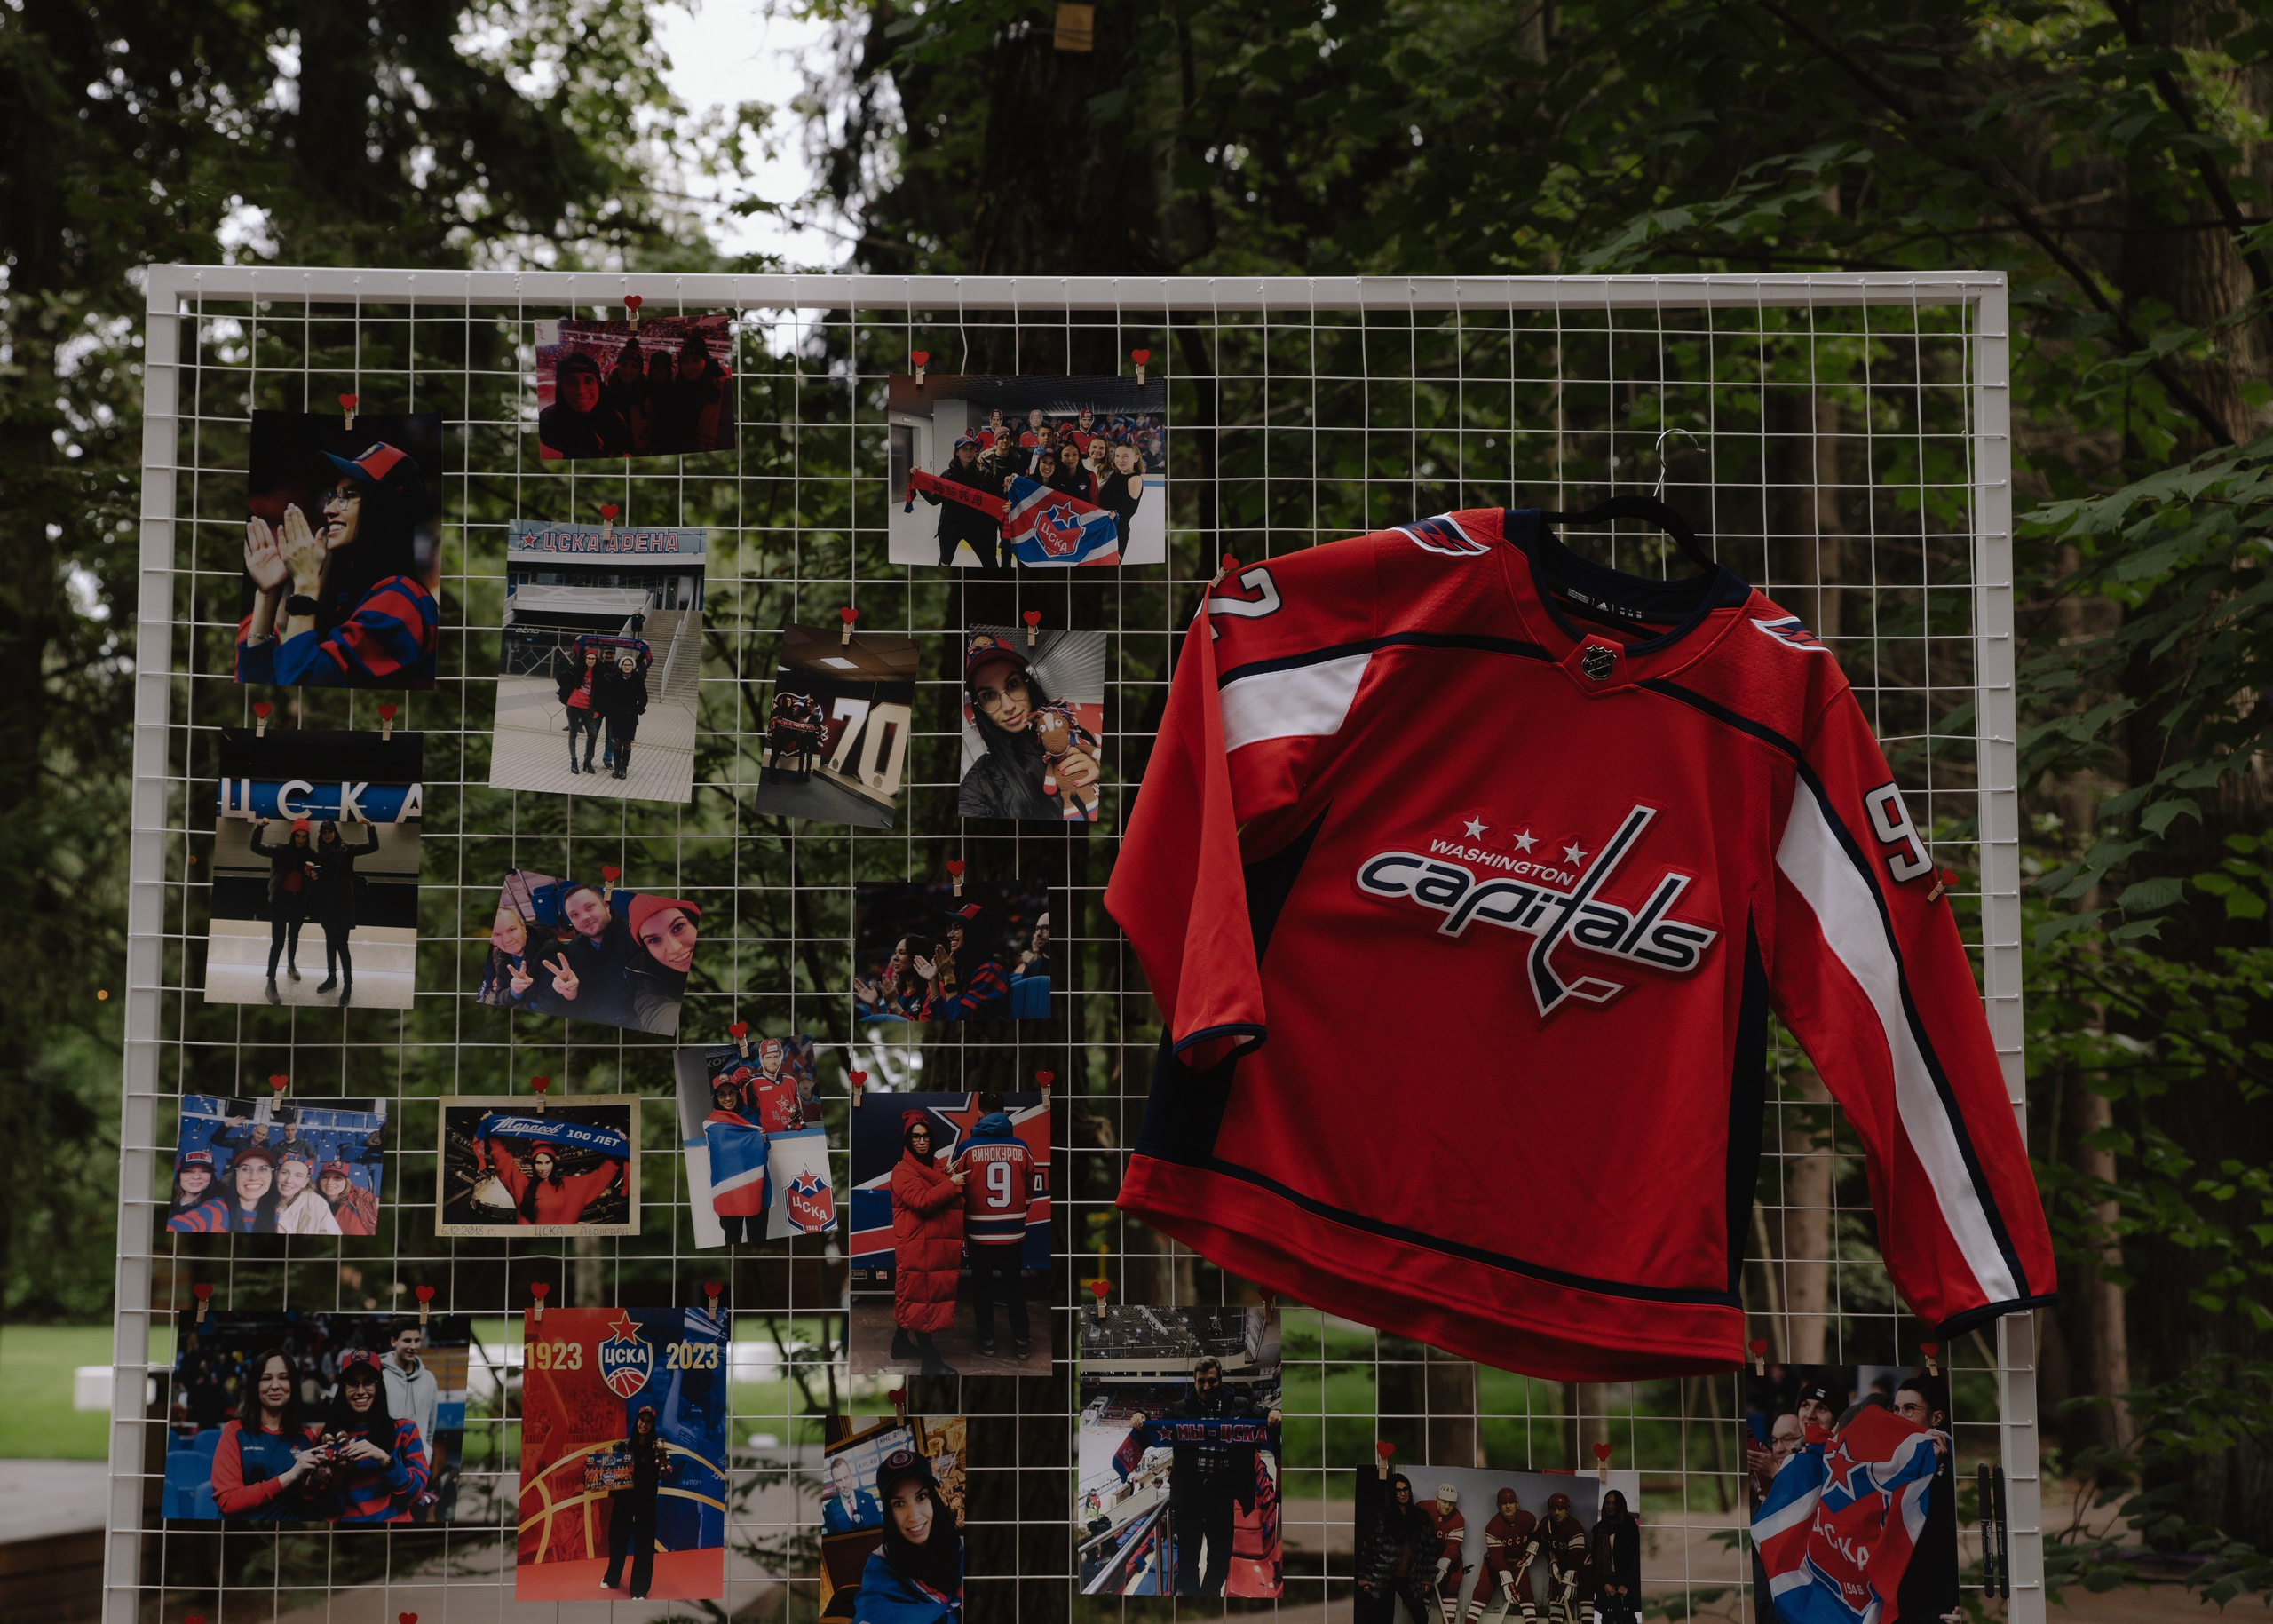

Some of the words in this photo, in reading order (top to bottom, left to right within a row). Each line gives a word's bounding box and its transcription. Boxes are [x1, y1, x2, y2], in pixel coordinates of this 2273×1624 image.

[543, 532, 600, 553] ЦСКА
[606, 532, 680, 553] АРЕНА
[1041, 522, 1068, 552] ЦСКА
[1588, 657, 1610, 670] NHL
[827, 697, 912, 796] 70
[220, 777, 423, 823] ЦСКА
[1864, 781, 1934, 884] 9
[1430, 837, 1576, 887] WASHINGTON
[490, 1116, 566, 1137] Тарасов
[566, 1129, 592, 1142] 100
[592, 1134, 621, 1147] ЛЕТ
[971, 1147, 1024, 1163] ВИНОКУРОВ
[986, 1161, 1012, 1208] 9
[792, 1196, 828, 1221] ЦСКА
[535, 1225, 564, 1238] ЦСКА
[524, 1342, 583, 1371] 1923
[604, 1348, 648, 1367] ЦСКА
[666, 1343, 720, 1370] 2023
[1176, 1424, 1205, 1441] МЫ
[1220, 1425, 1268, 1443] ЦСКА
[858, 1458, 878, 1469] KHL.RU
[1501, 1535, 1528, 1548] СССР
[1843, 1582, 1865, 1596] 1946
